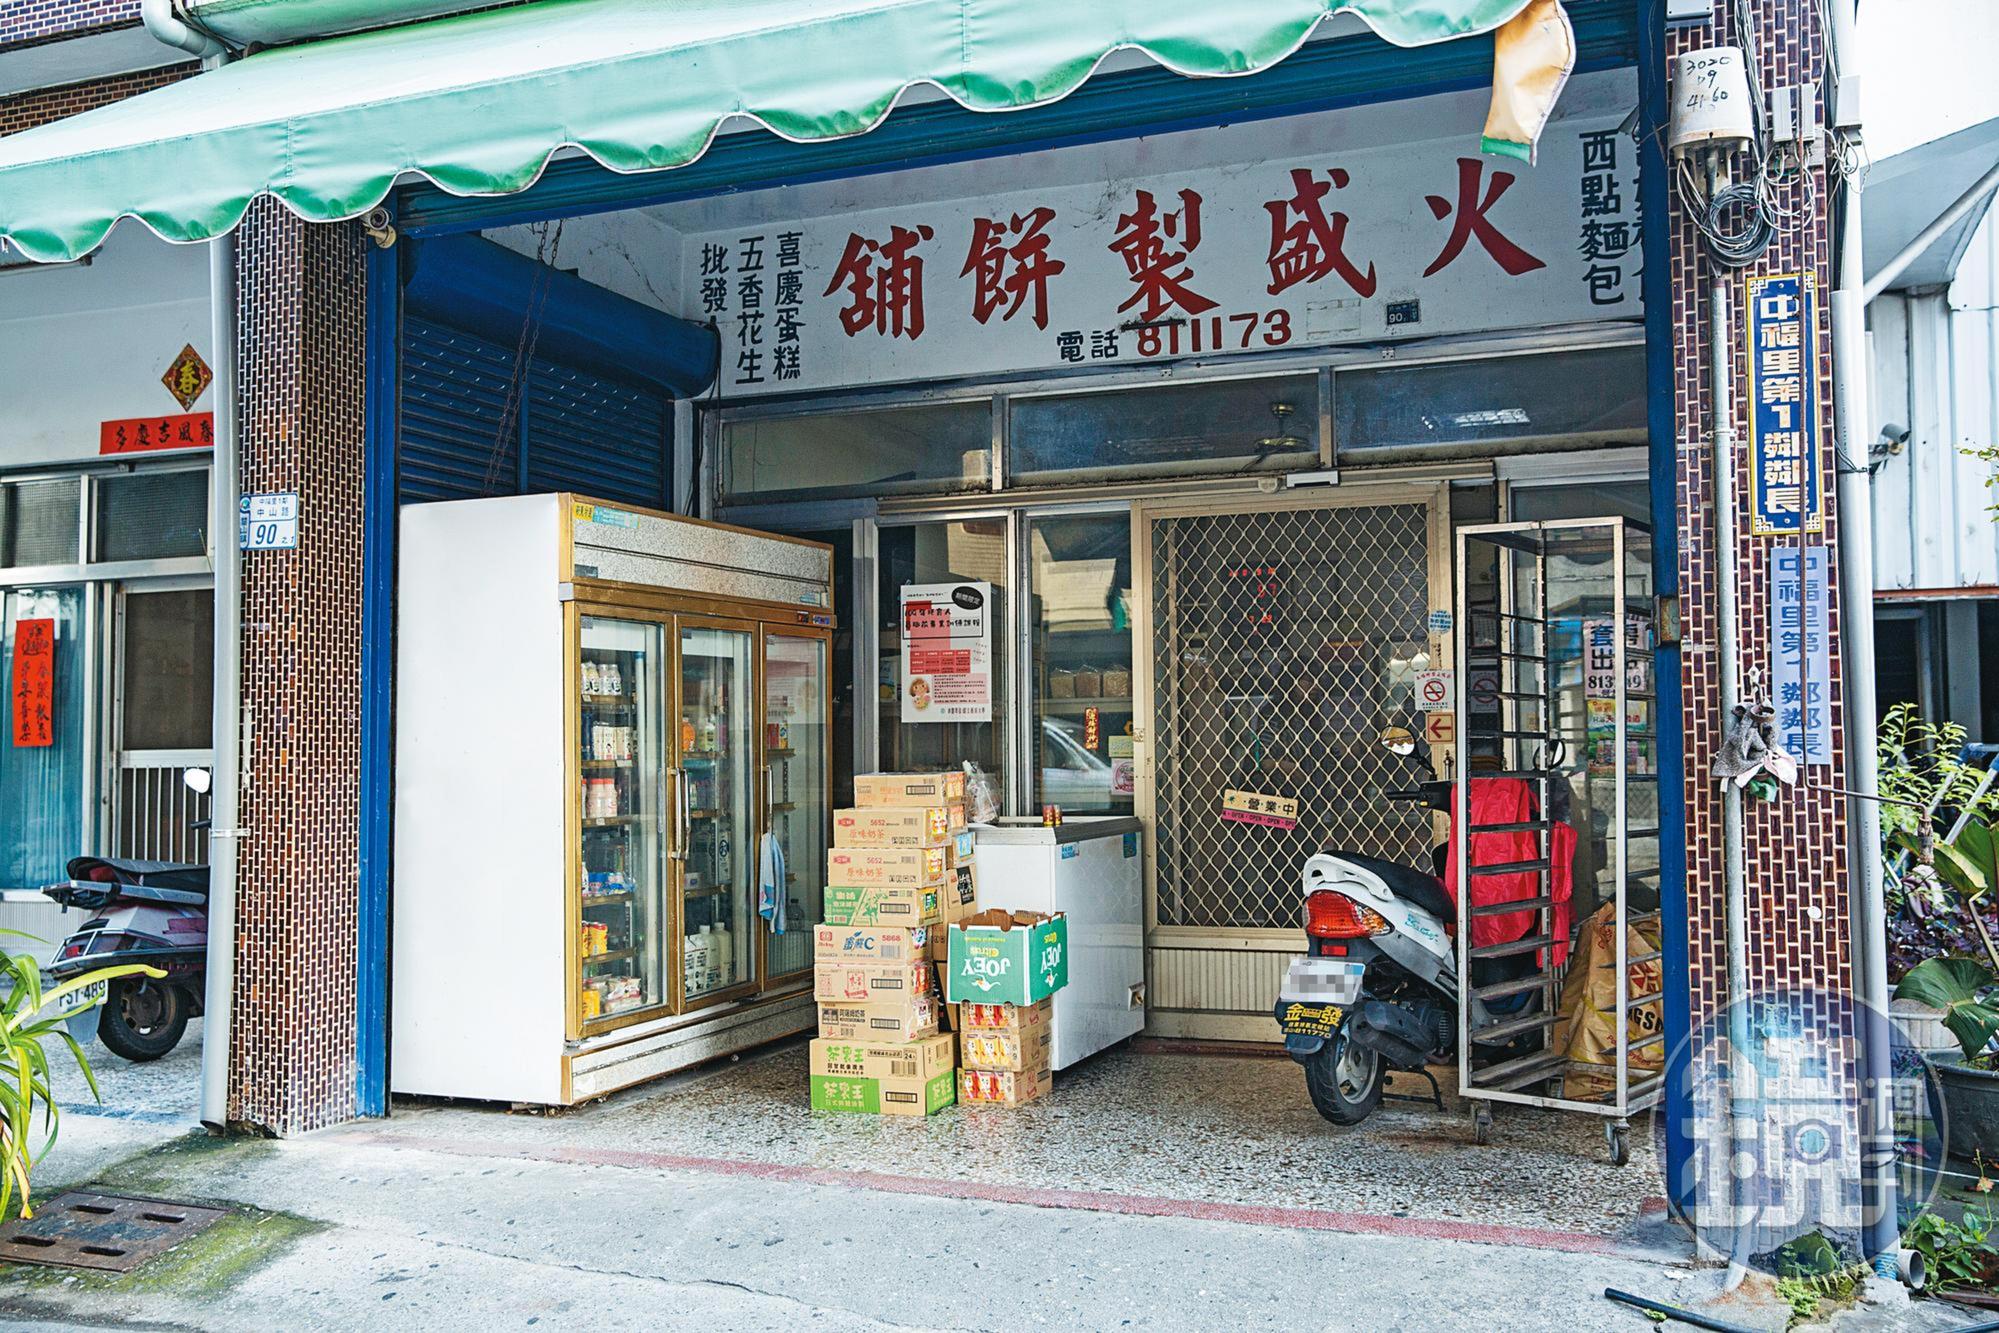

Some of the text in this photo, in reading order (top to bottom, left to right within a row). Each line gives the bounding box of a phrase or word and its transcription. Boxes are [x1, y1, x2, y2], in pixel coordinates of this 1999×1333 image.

[1577, 128, 1630, 306] 西點麵包
[735, 236, 765, 385] 五香花生
[772, 231, 806, 381] 喜慶蛋糕
[1057, 308, 1292, 363] 電話 811173
[179, 359, 200, 394] 春
[255, 523, 278, 545] 90
[961, 956, 1011, 977] JOEY
[1040, 943, 1062, 974] JOEY
